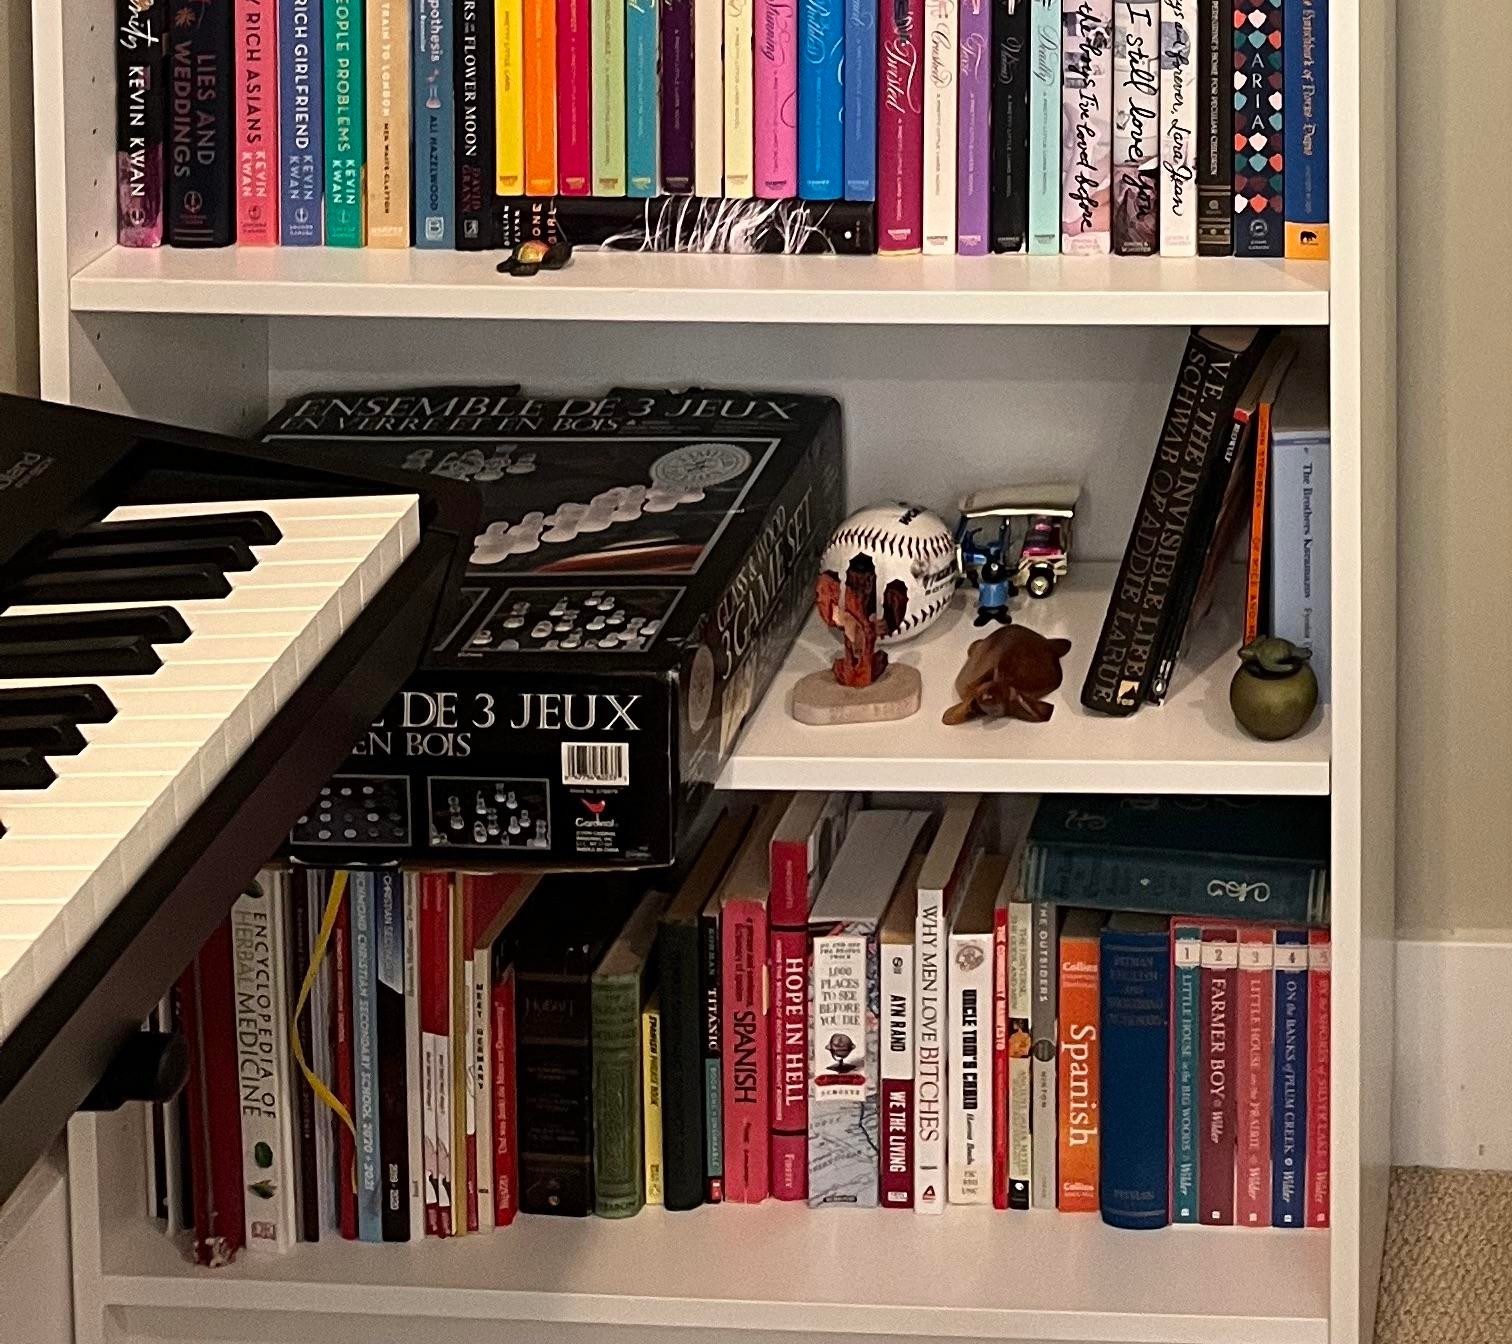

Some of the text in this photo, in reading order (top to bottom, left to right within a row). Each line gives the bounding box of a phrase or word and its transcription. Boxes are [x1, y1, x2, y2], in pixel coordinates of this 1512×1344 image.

[245, 8, 262, 62] RICH
[128, 66, 145, 197] KEVIN KWAN
[246, 69, 261, 144] ASIANS
[403, 692, 642, 730] DE 3 JEUX
[406, 733, 471, 756] BOIS
[237, 991, 261, 1116] MEDICINE
[253, 913, 276, 1119] ENCYCLOPEDIA OF
[784, 957, 804, 1106] HOPE IN HELL
[890, 994, 905, 1051] AYN RAND
[920, 906, 939, 1143] WHY MEN LOVE BITCHES
[1067, 1024, 1097, 1146] Spanish
